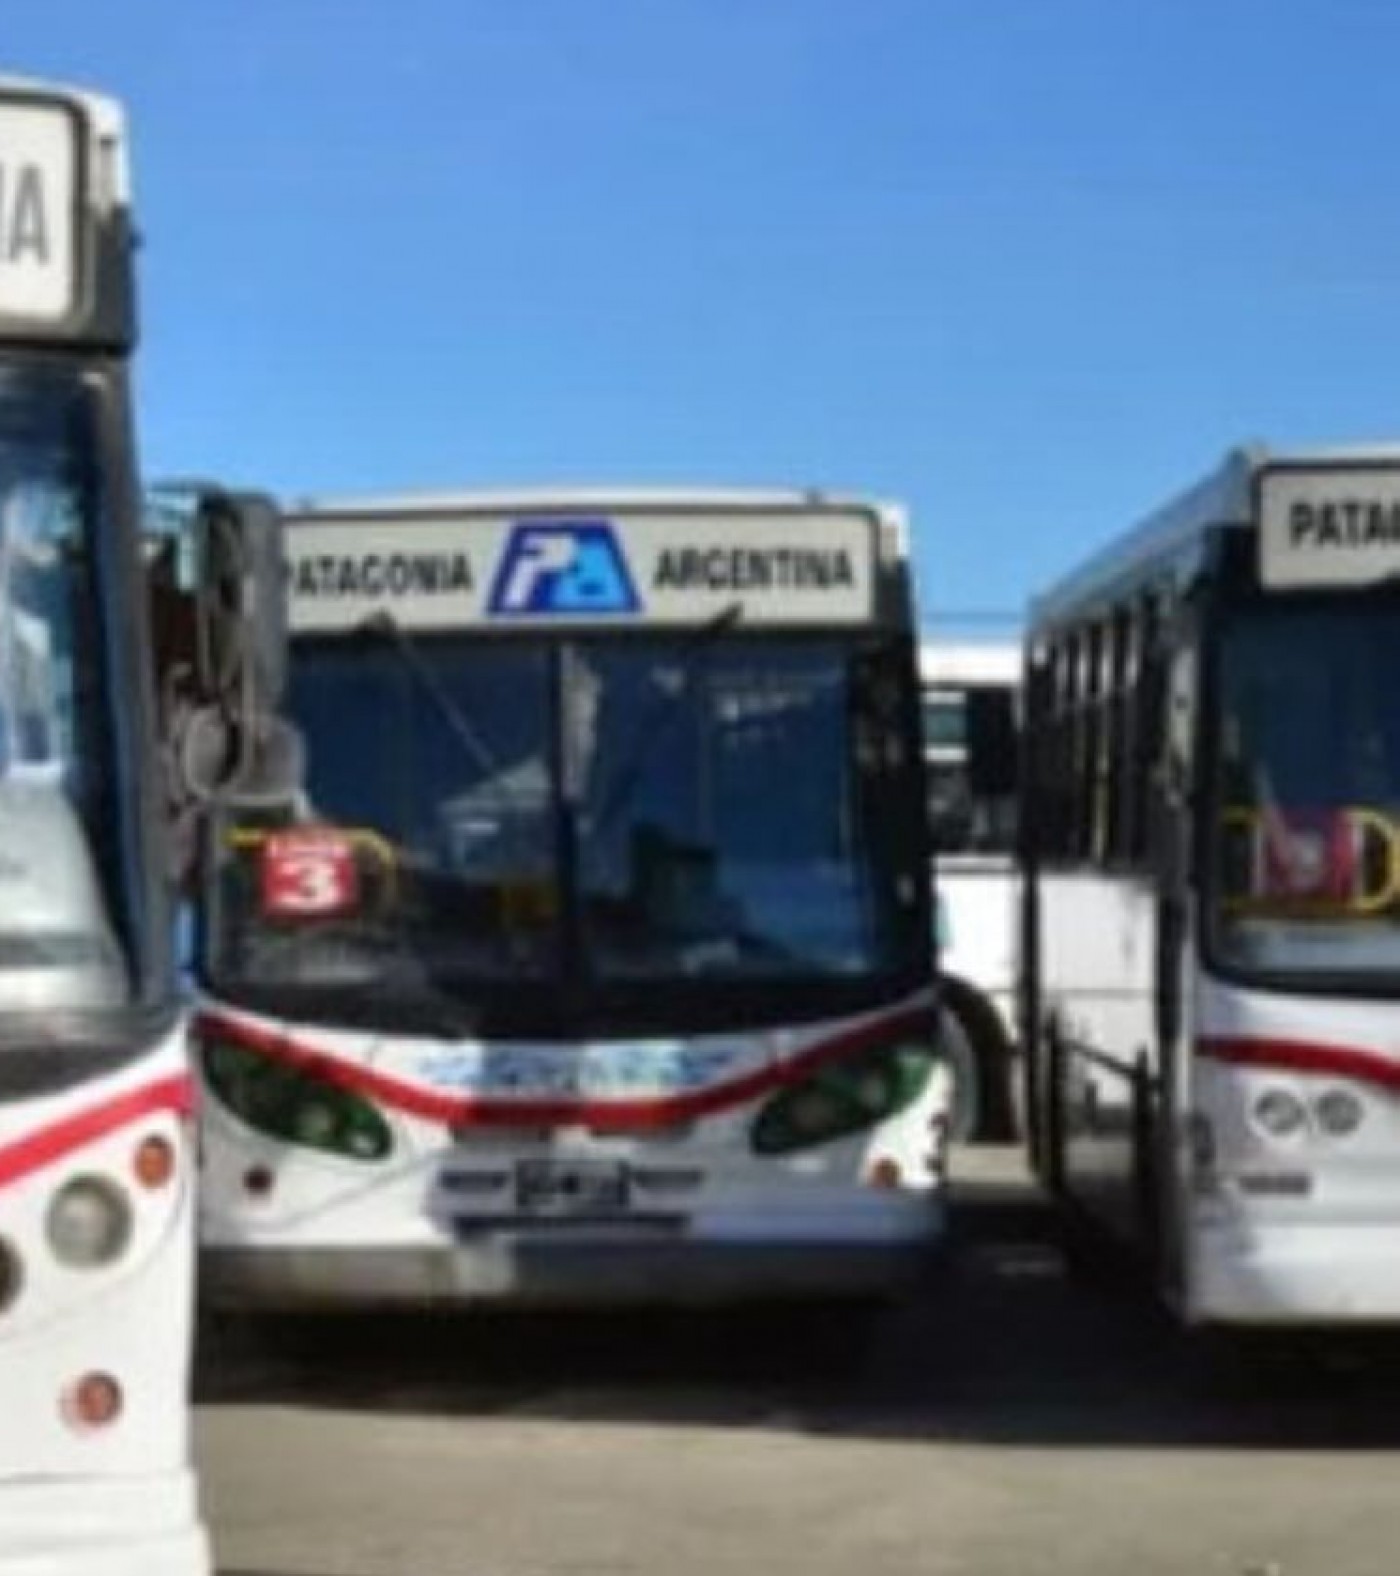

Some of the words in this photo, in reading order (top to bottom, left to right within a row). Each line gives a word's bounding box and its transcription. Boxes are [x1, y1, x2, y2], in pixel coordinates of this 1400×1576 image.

[285, 552, 475, 598] ATAGONIA
[653, 546, 853, 593] ARGENTINA
[277, 857, 341, 911] 3
